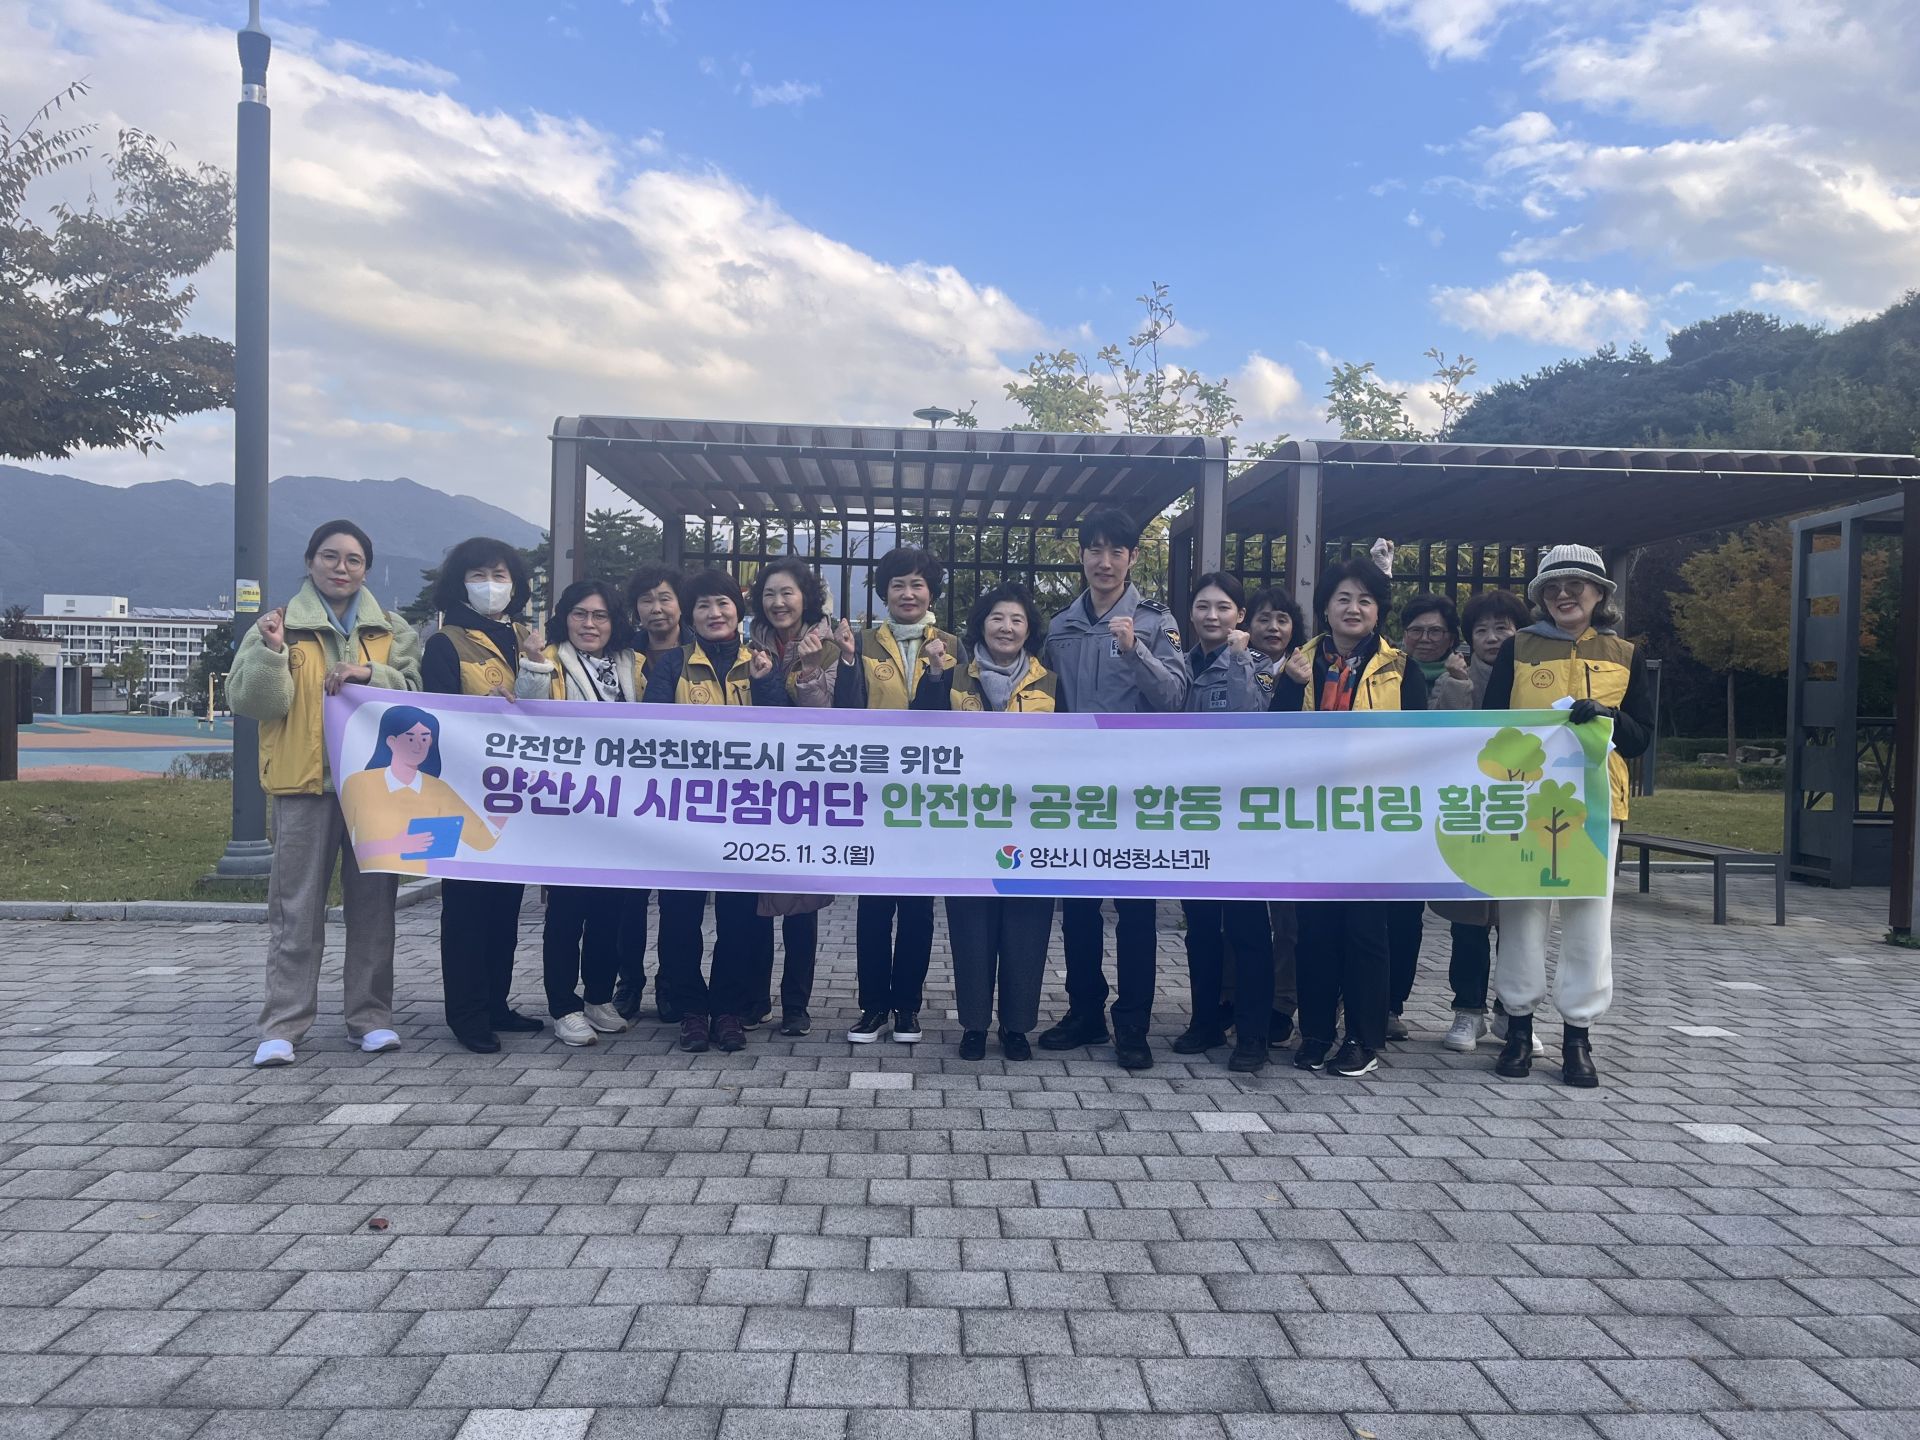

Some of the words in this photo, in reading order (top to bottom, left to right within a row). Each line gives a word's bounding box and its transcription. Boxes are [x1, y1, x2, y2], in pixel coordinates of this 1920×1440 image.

[486, 733, 585, 764] 안전한
[595, 738, 784, 772] 여성친화도시
[795, 744, 889, 773] 조성을
[900, 746, 963, 774] 위한
[483, 767, 621, 817] 양산시
[634, 778, 868, 827] 시민참여단
[882, 783, 1016, 828] 안전한
[1029, 785, 1117, 829] 공원
[1134, 785, 1221, 830] 합동
[1238, 785, 1422, 831] 모니터링
[1438, 784, 1525, 832] 활동
[723, 842, 790, 862] 2025.
[797, 845, 815, 863] 11.
[1030, 848, 1087, 868] 양산시
[1093, 849, 1210, 870] 여성청소년과
